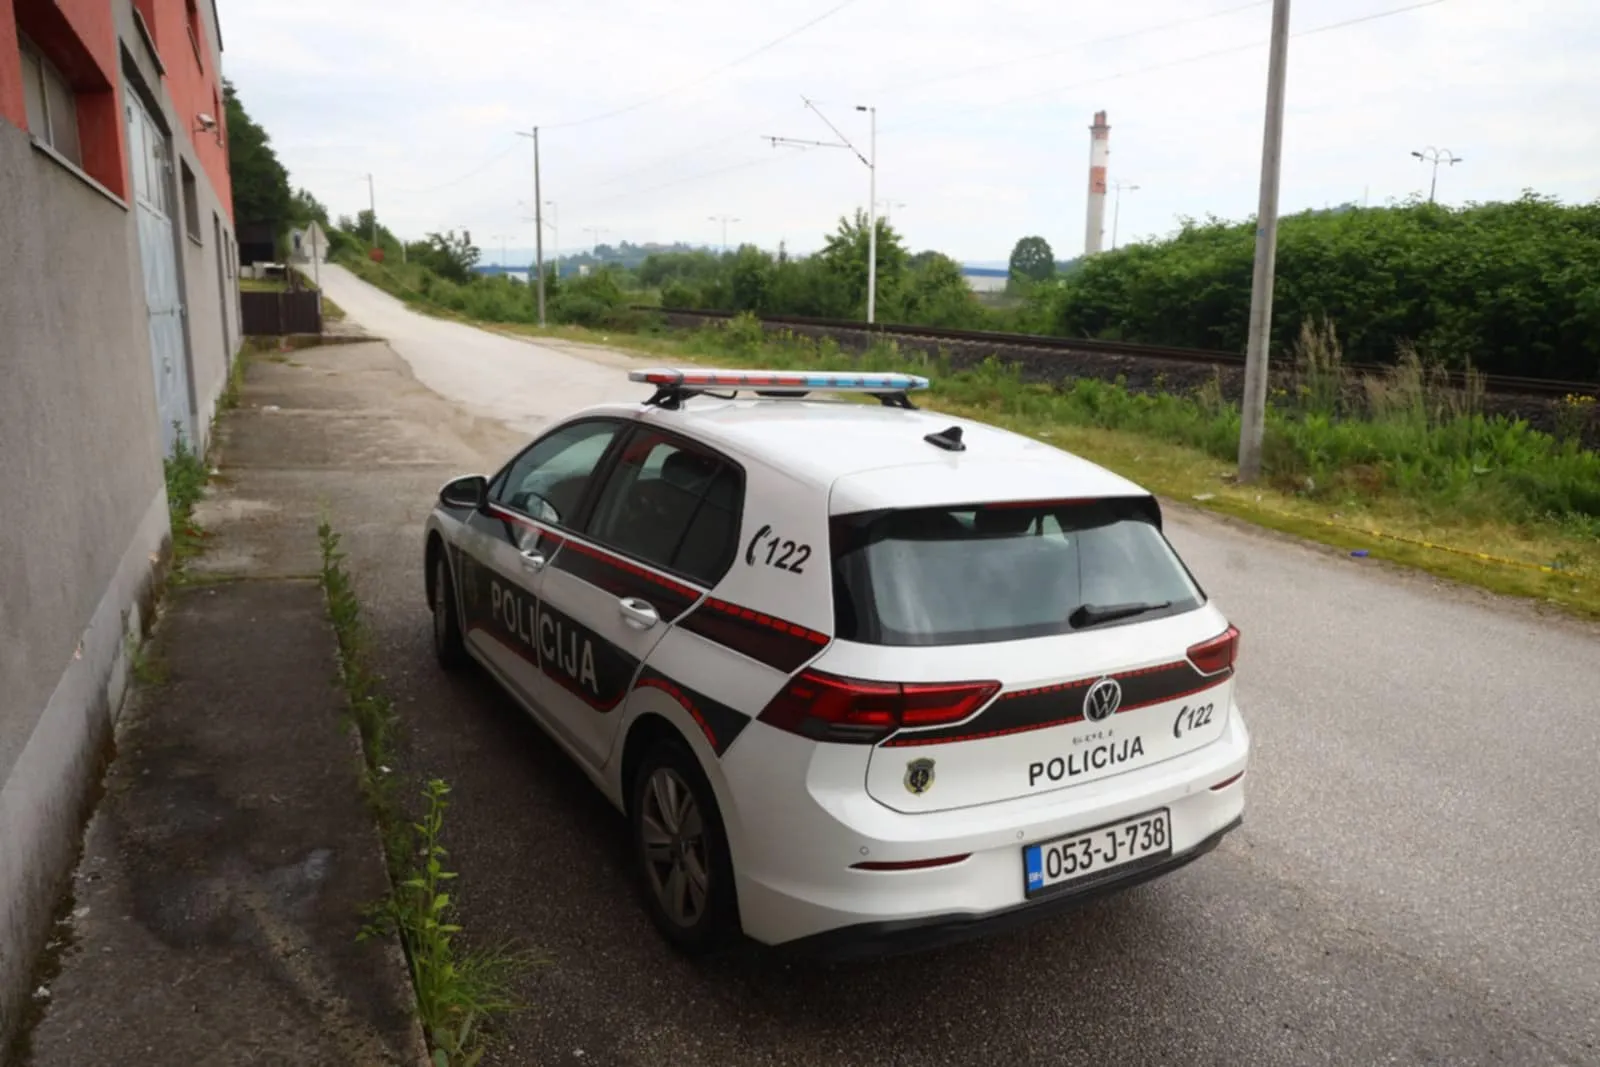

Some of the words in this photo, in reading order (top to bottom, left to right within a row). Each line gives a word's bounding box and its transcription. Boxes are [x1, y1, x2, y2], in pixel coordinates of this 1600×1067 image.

[765, 537, 811, 574] 122
[491, 581, 598, 693] POLICIJA
[1187, 702, 1213, 730] 122
[1029, 736, 1143, 786] POLICIJA
[1046, 817, 1165, 878] 053-J-738
